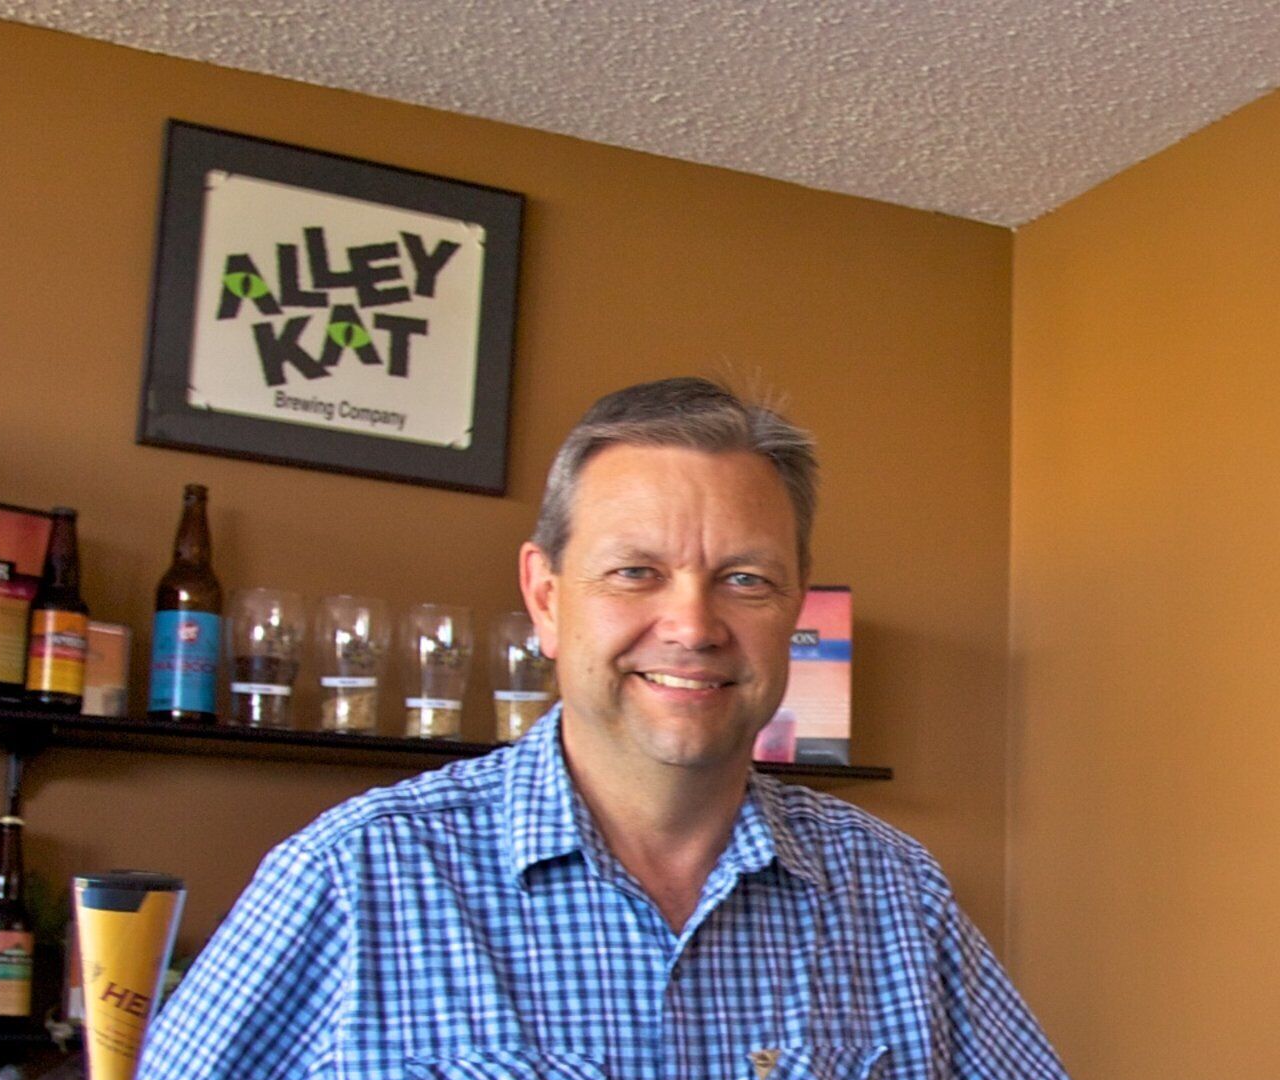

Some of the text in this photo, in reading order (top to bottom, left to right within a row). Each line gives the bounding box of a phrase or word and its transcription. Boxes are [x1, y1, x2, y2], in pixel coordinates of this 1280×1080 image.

[216, 227, 461, 320] ALLEY
[252, 304, 428, 386] KAT
[274, 390, 406, 431] Brewing Company
[791, 632, 818, 645] ON
[100, 981, 152, 1019] HE
